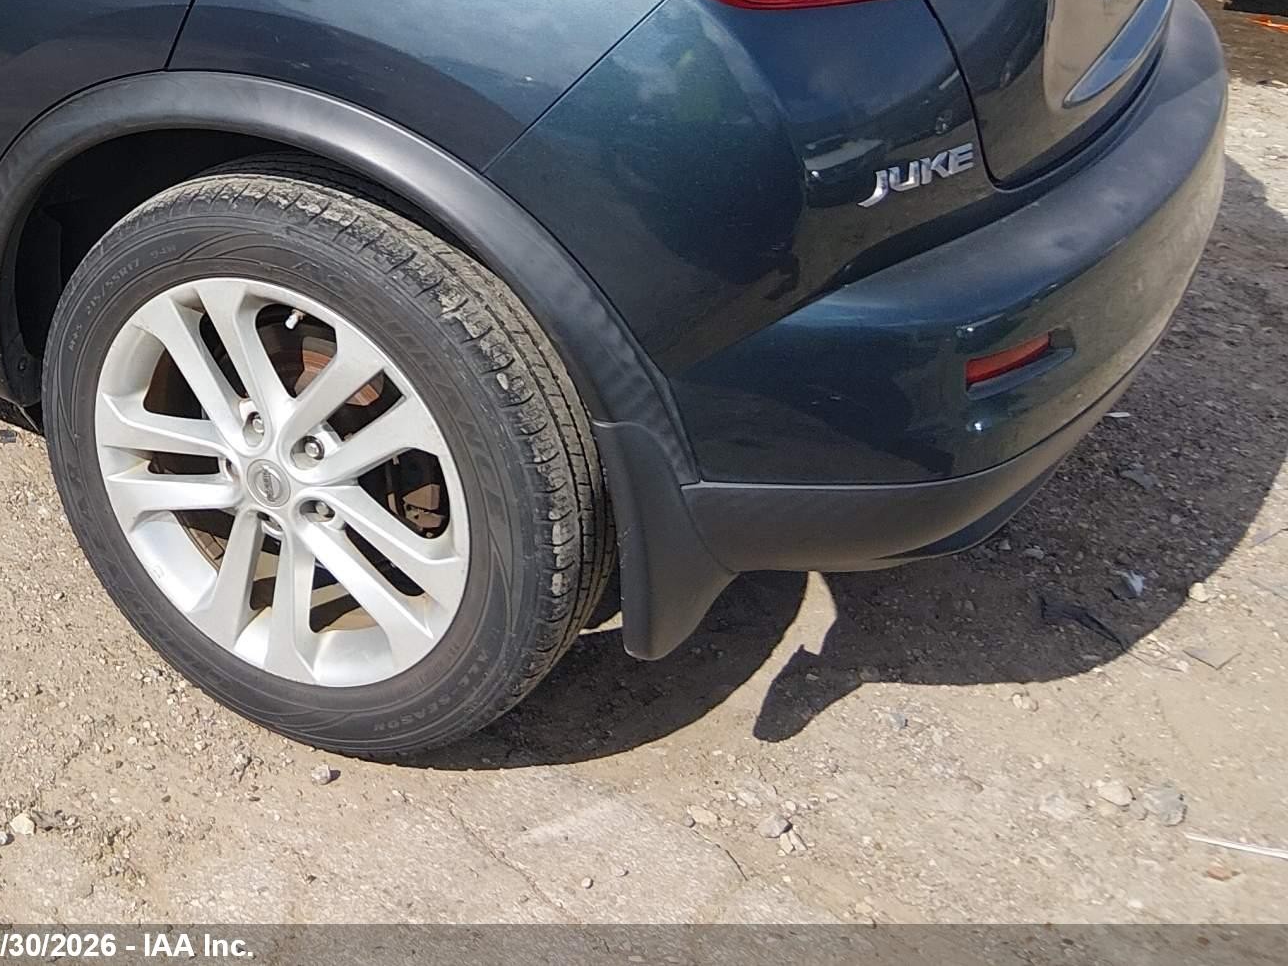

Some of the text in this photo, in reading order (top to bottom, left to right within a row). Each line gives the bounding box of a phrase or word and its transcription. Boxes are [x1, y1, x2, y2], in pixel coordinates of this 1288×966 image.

[857, 142, 974, 208] JUKE
[82, 254, 143, 318] 215/55R17
[366, 646, 493, 732] ALL-SEASON
